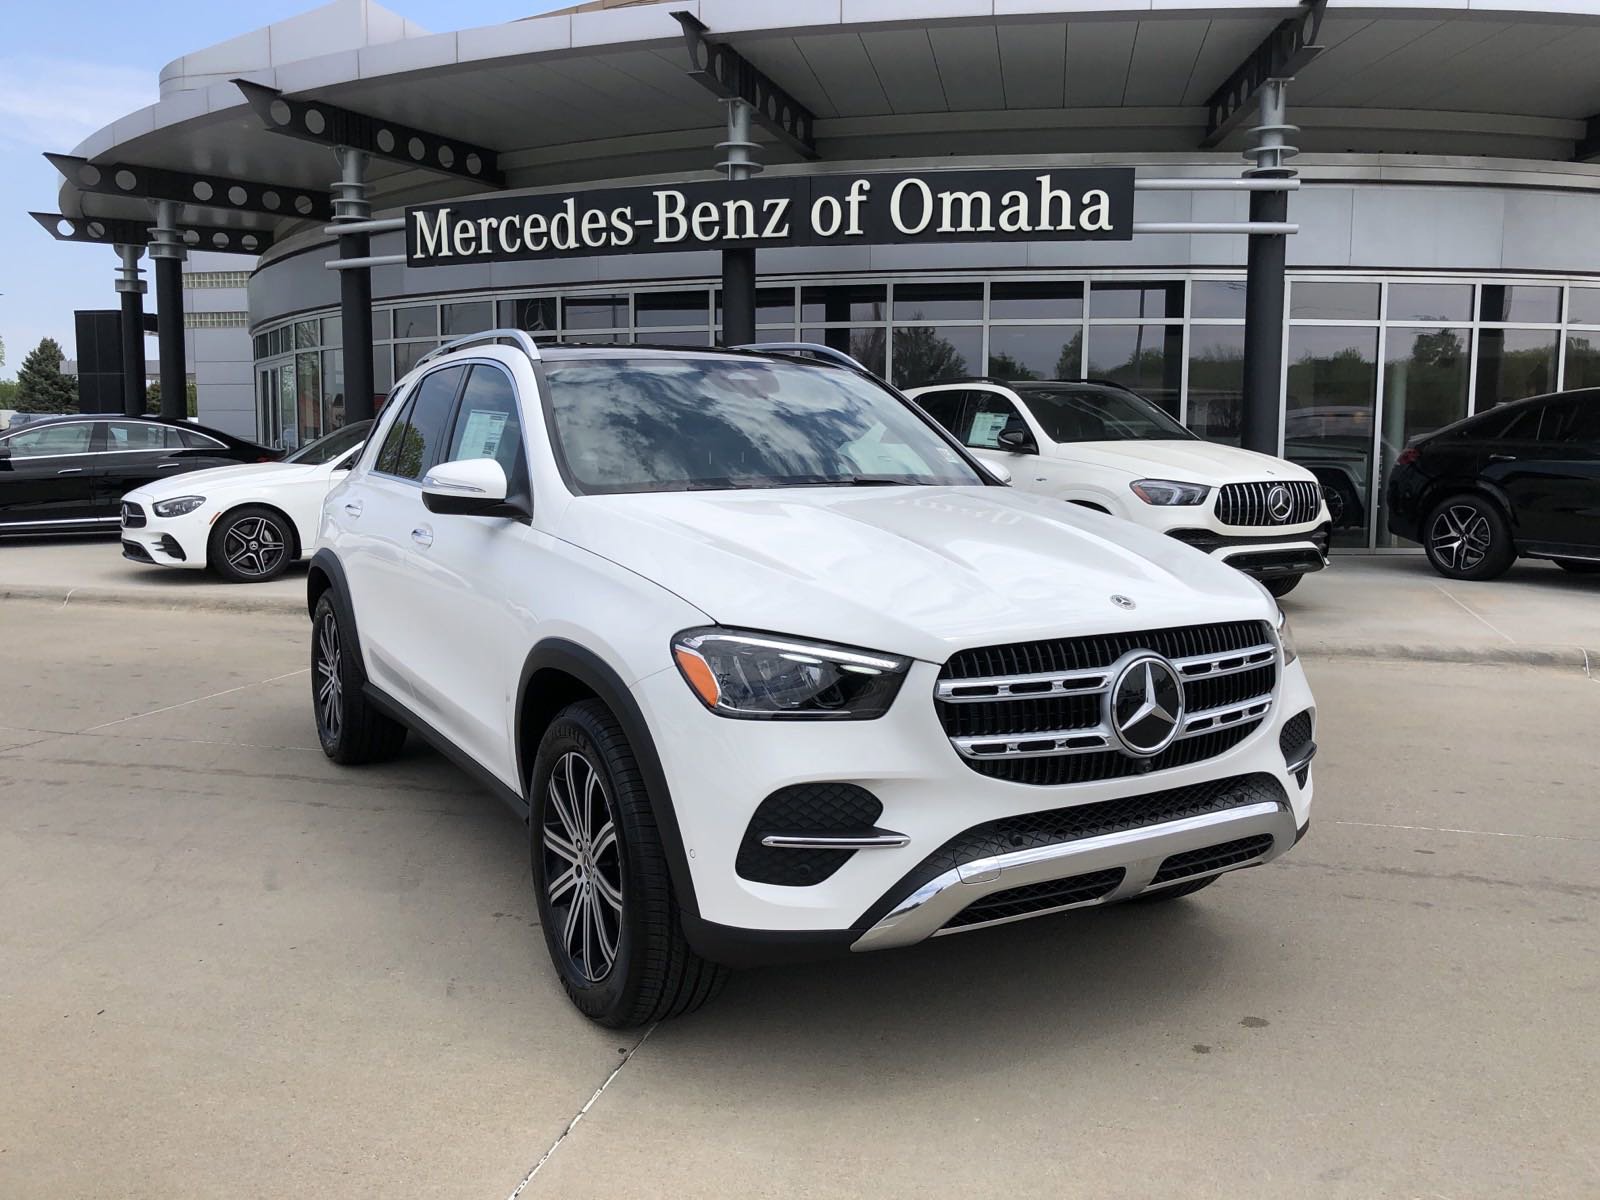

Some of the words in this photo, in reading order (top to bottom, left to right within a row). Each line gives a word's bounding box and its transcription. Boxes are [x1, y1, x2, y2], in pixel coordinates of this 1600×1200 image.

[412, 190, 791, 260] Mercedes-Benz
[811, 179, 871, 238] of
[890, 174, 1114, 236] Omaha
